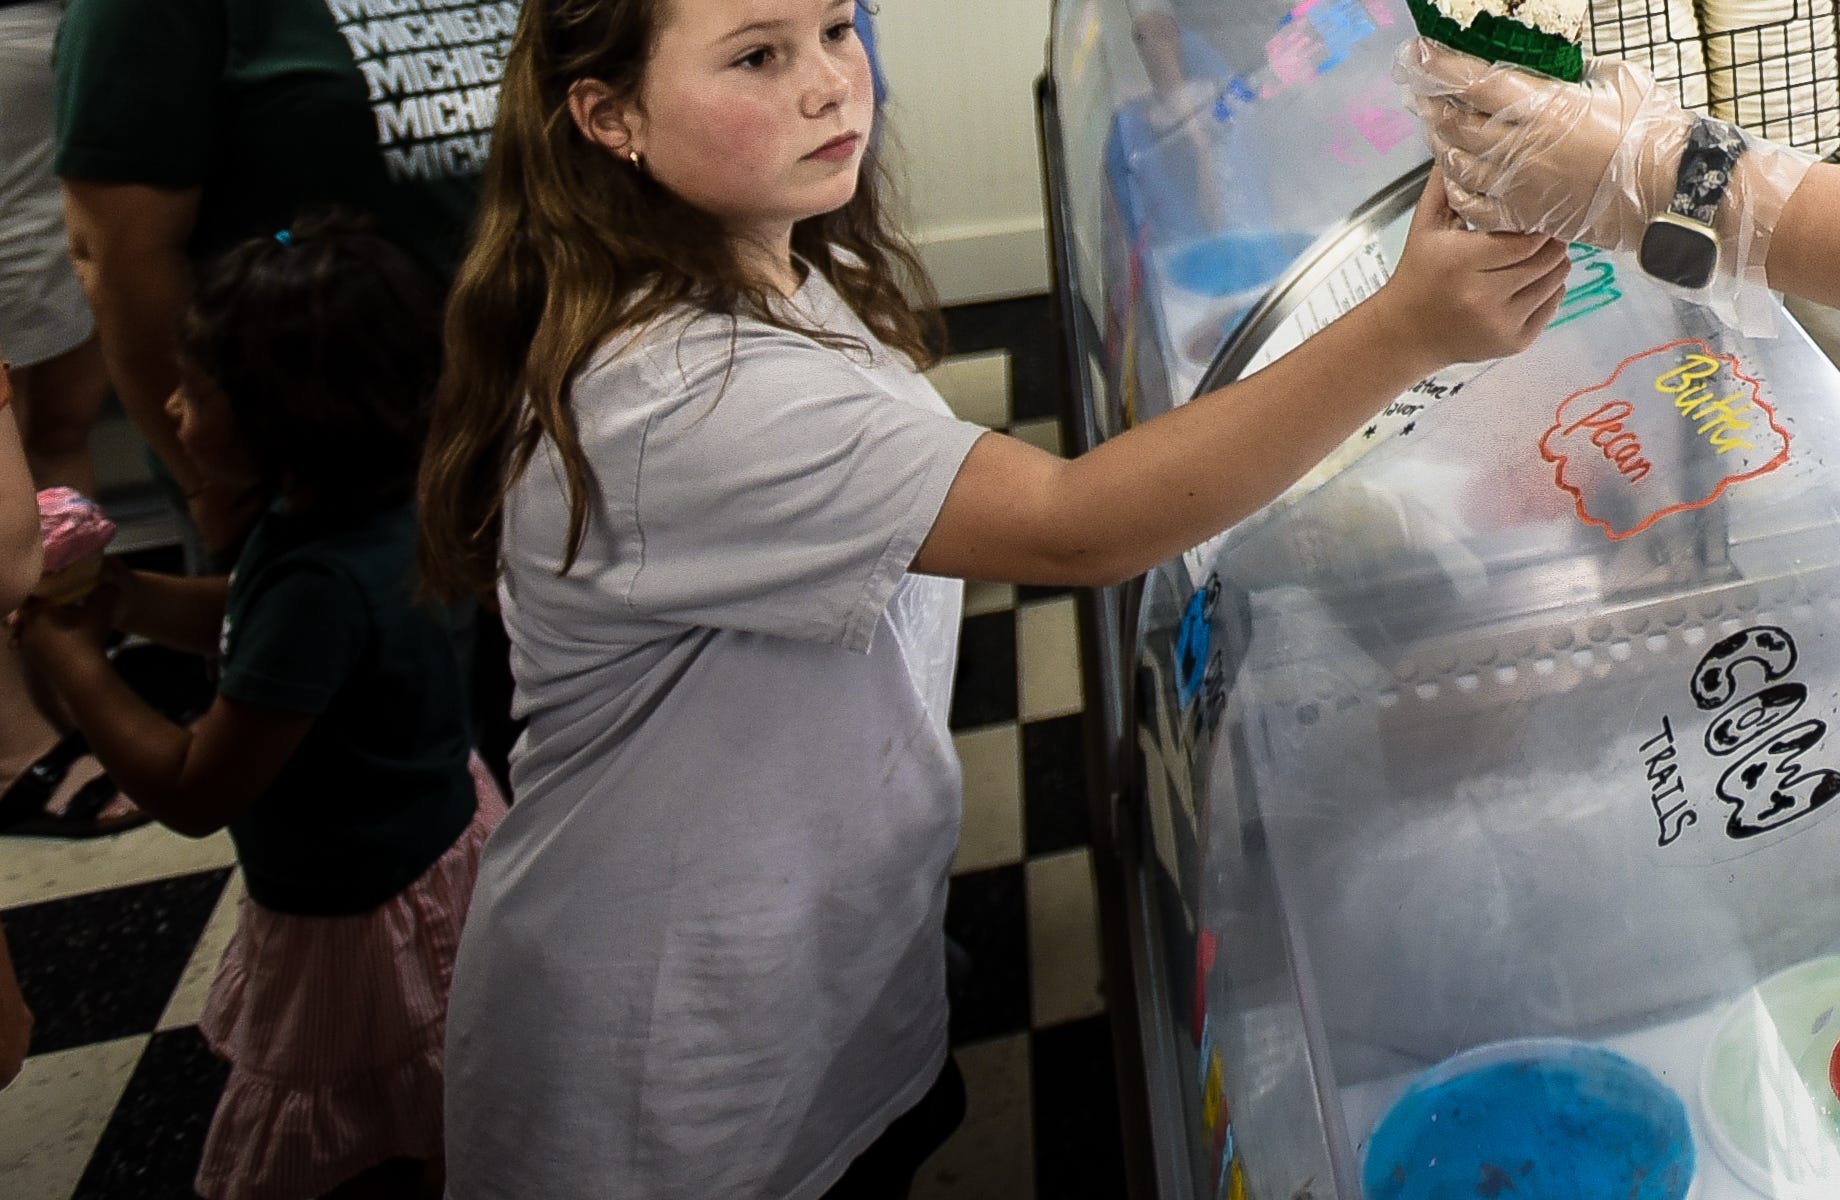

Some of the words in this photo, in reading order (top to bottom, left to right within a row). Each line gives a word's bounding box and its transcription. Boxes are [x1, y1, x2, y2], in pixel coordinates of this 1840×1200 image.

[357, 40, 512, 101] MICHIG
[371, 83, 502, 145] MICHI
[1562, 399, 1652, 484] Pecan
[1638, 714, 1698, 848] TRAILS
